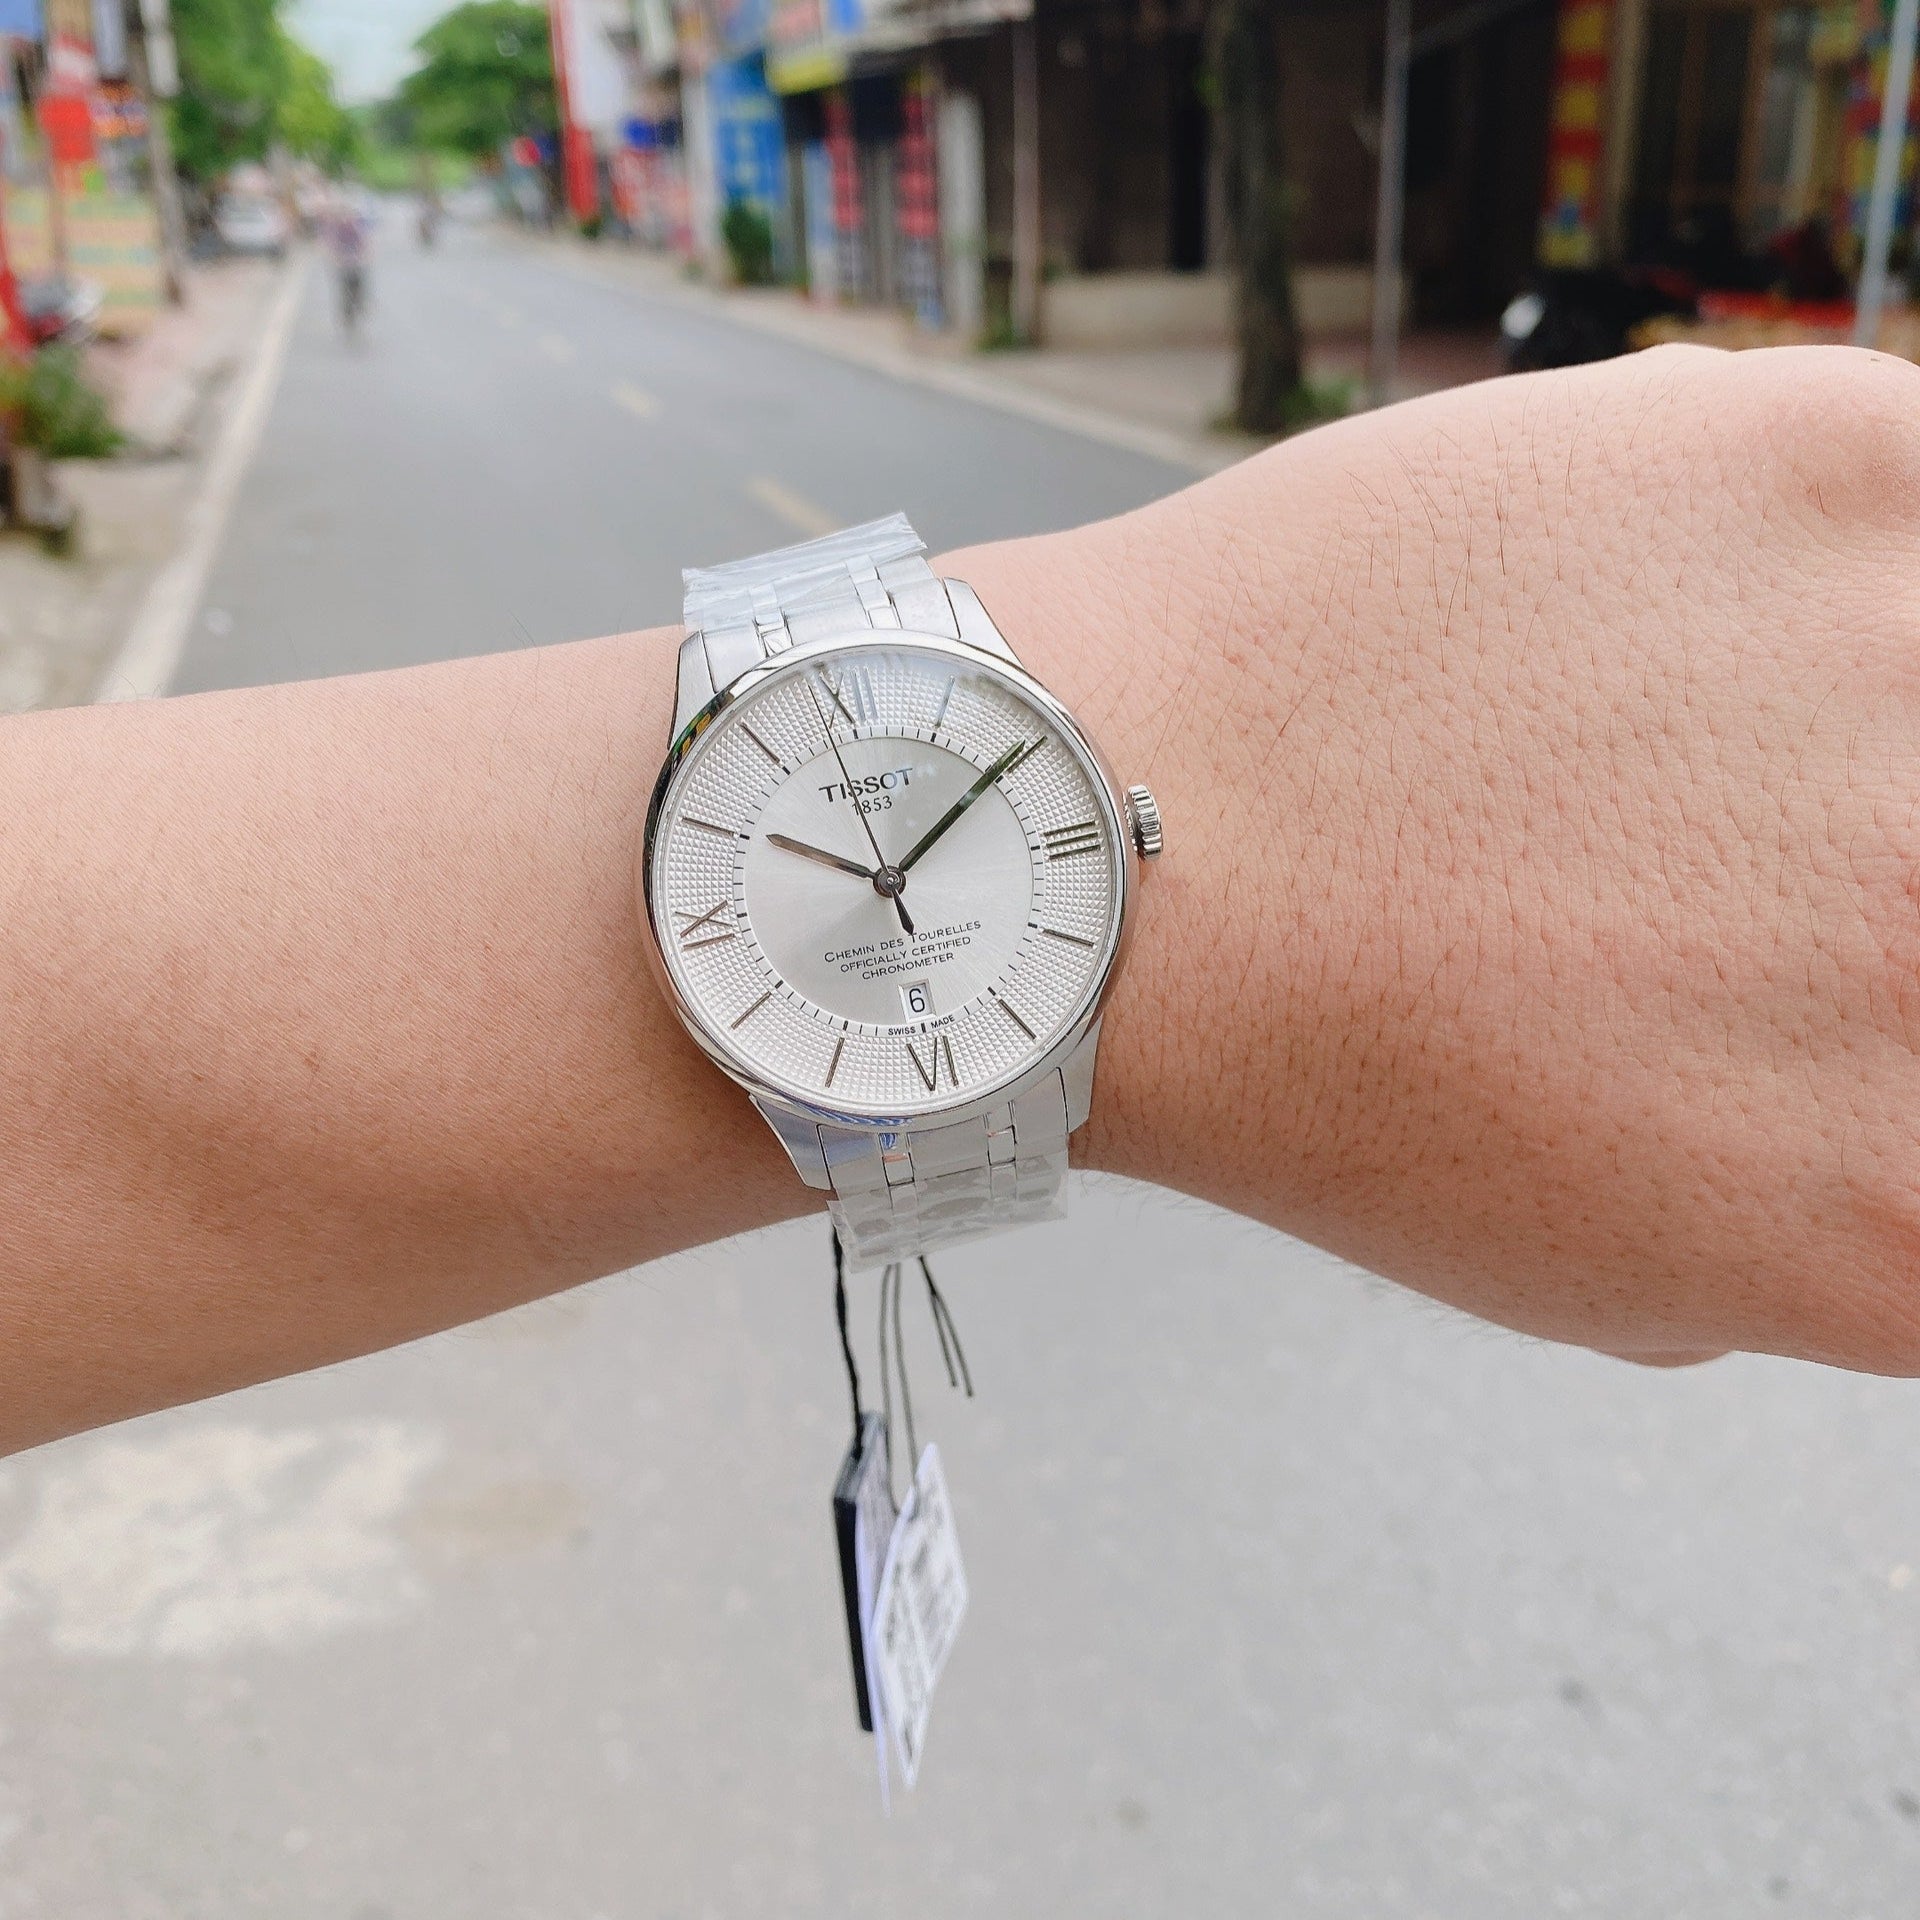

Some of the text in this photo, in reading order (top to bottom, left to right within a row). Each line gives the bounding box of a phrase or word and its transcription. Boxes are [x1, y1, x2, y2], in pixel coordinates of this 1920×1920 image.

[818, 767, 914, 803] TISSOT
[852, 795, 893, 815] 1853
[824, 920, 981, 963] CHEMIN DES TOURELLES
[840, 936, 971, 973] OFFICIALLY CERTIFIED
[861, 952, 955, 980] CHRONOMETER
[908, 988, 926, 1013] 6
[887, 1015, 955, 1036] SWISS MADE
